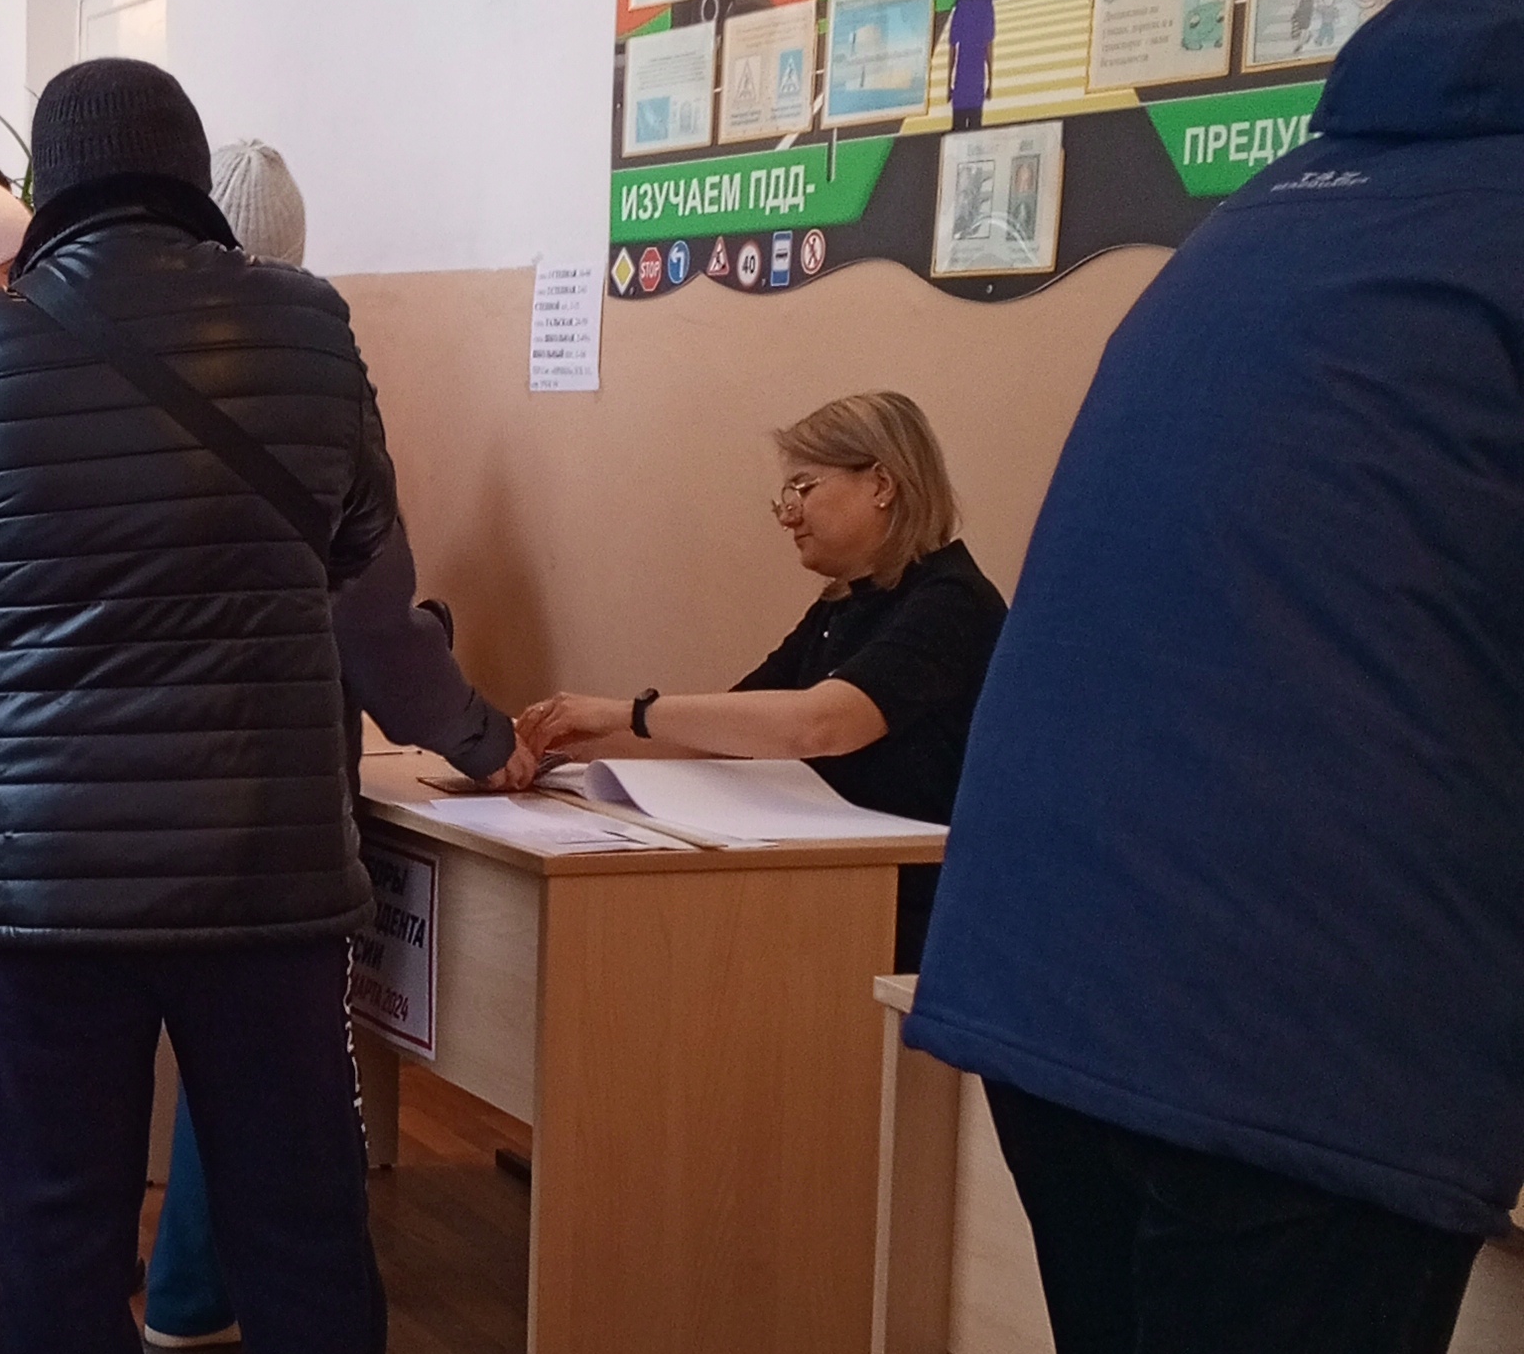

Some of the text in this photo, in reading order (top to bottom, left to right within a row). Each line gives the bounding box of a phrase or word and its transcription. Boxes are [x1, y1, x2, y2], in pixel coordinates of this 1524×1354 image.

[621, 172, 741, 222] ИЗУЧАЕМ
[640, 261, 660, 278] STOP
[741, 255, 756, 274] 40
